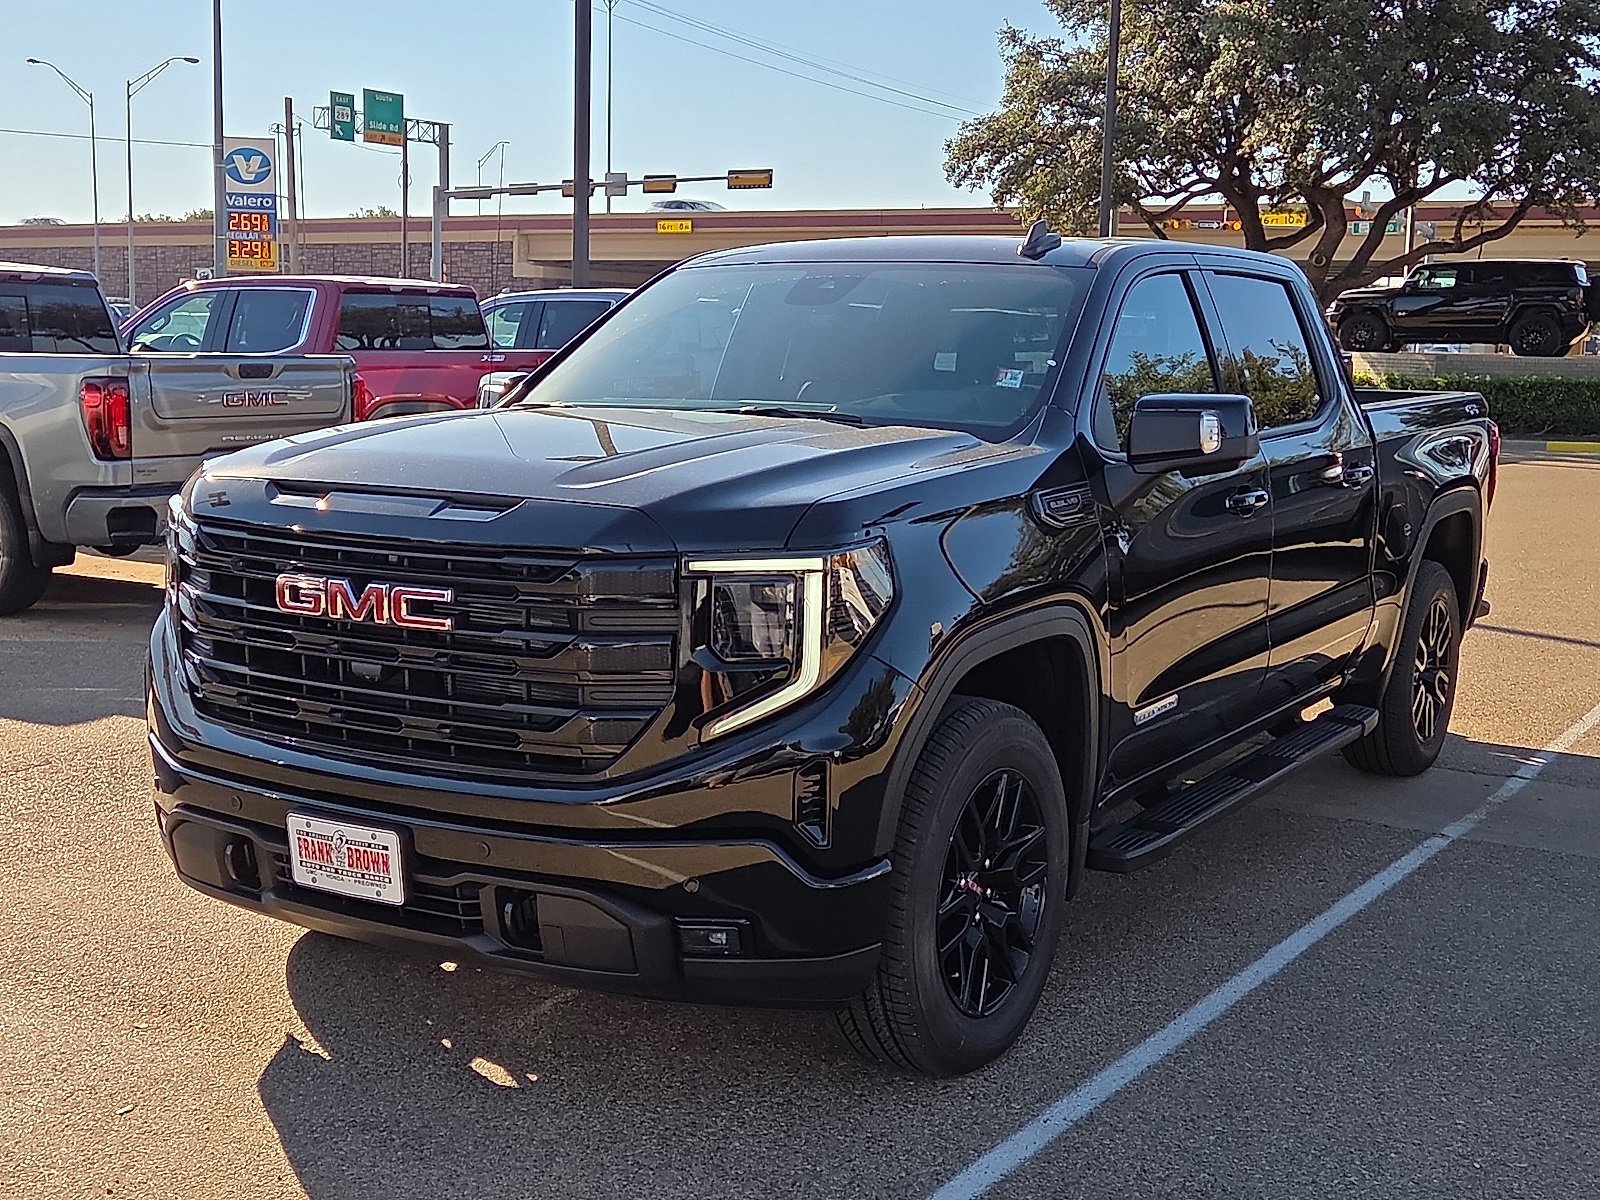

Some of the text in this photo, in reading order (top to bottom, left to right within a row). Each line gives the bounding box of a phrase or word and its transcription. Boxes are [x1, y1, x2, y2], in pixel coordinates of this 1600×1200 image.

[336, 111, 350, 120] 289
[369, 120, 399, 132] Slide Rd
[225, 194, 273, 207] Valero
[226, 231, 259, 240] REGULAR
[230, 259, 254, 268] DIESEL
[223, 390, 290, 408] GMC
[276, 573, 453, 631] GMC
[296, 836, 335, 866] FRANK
[346, 846, 391, 877] BROWN
[301, 861, 321, 870] AUTO
